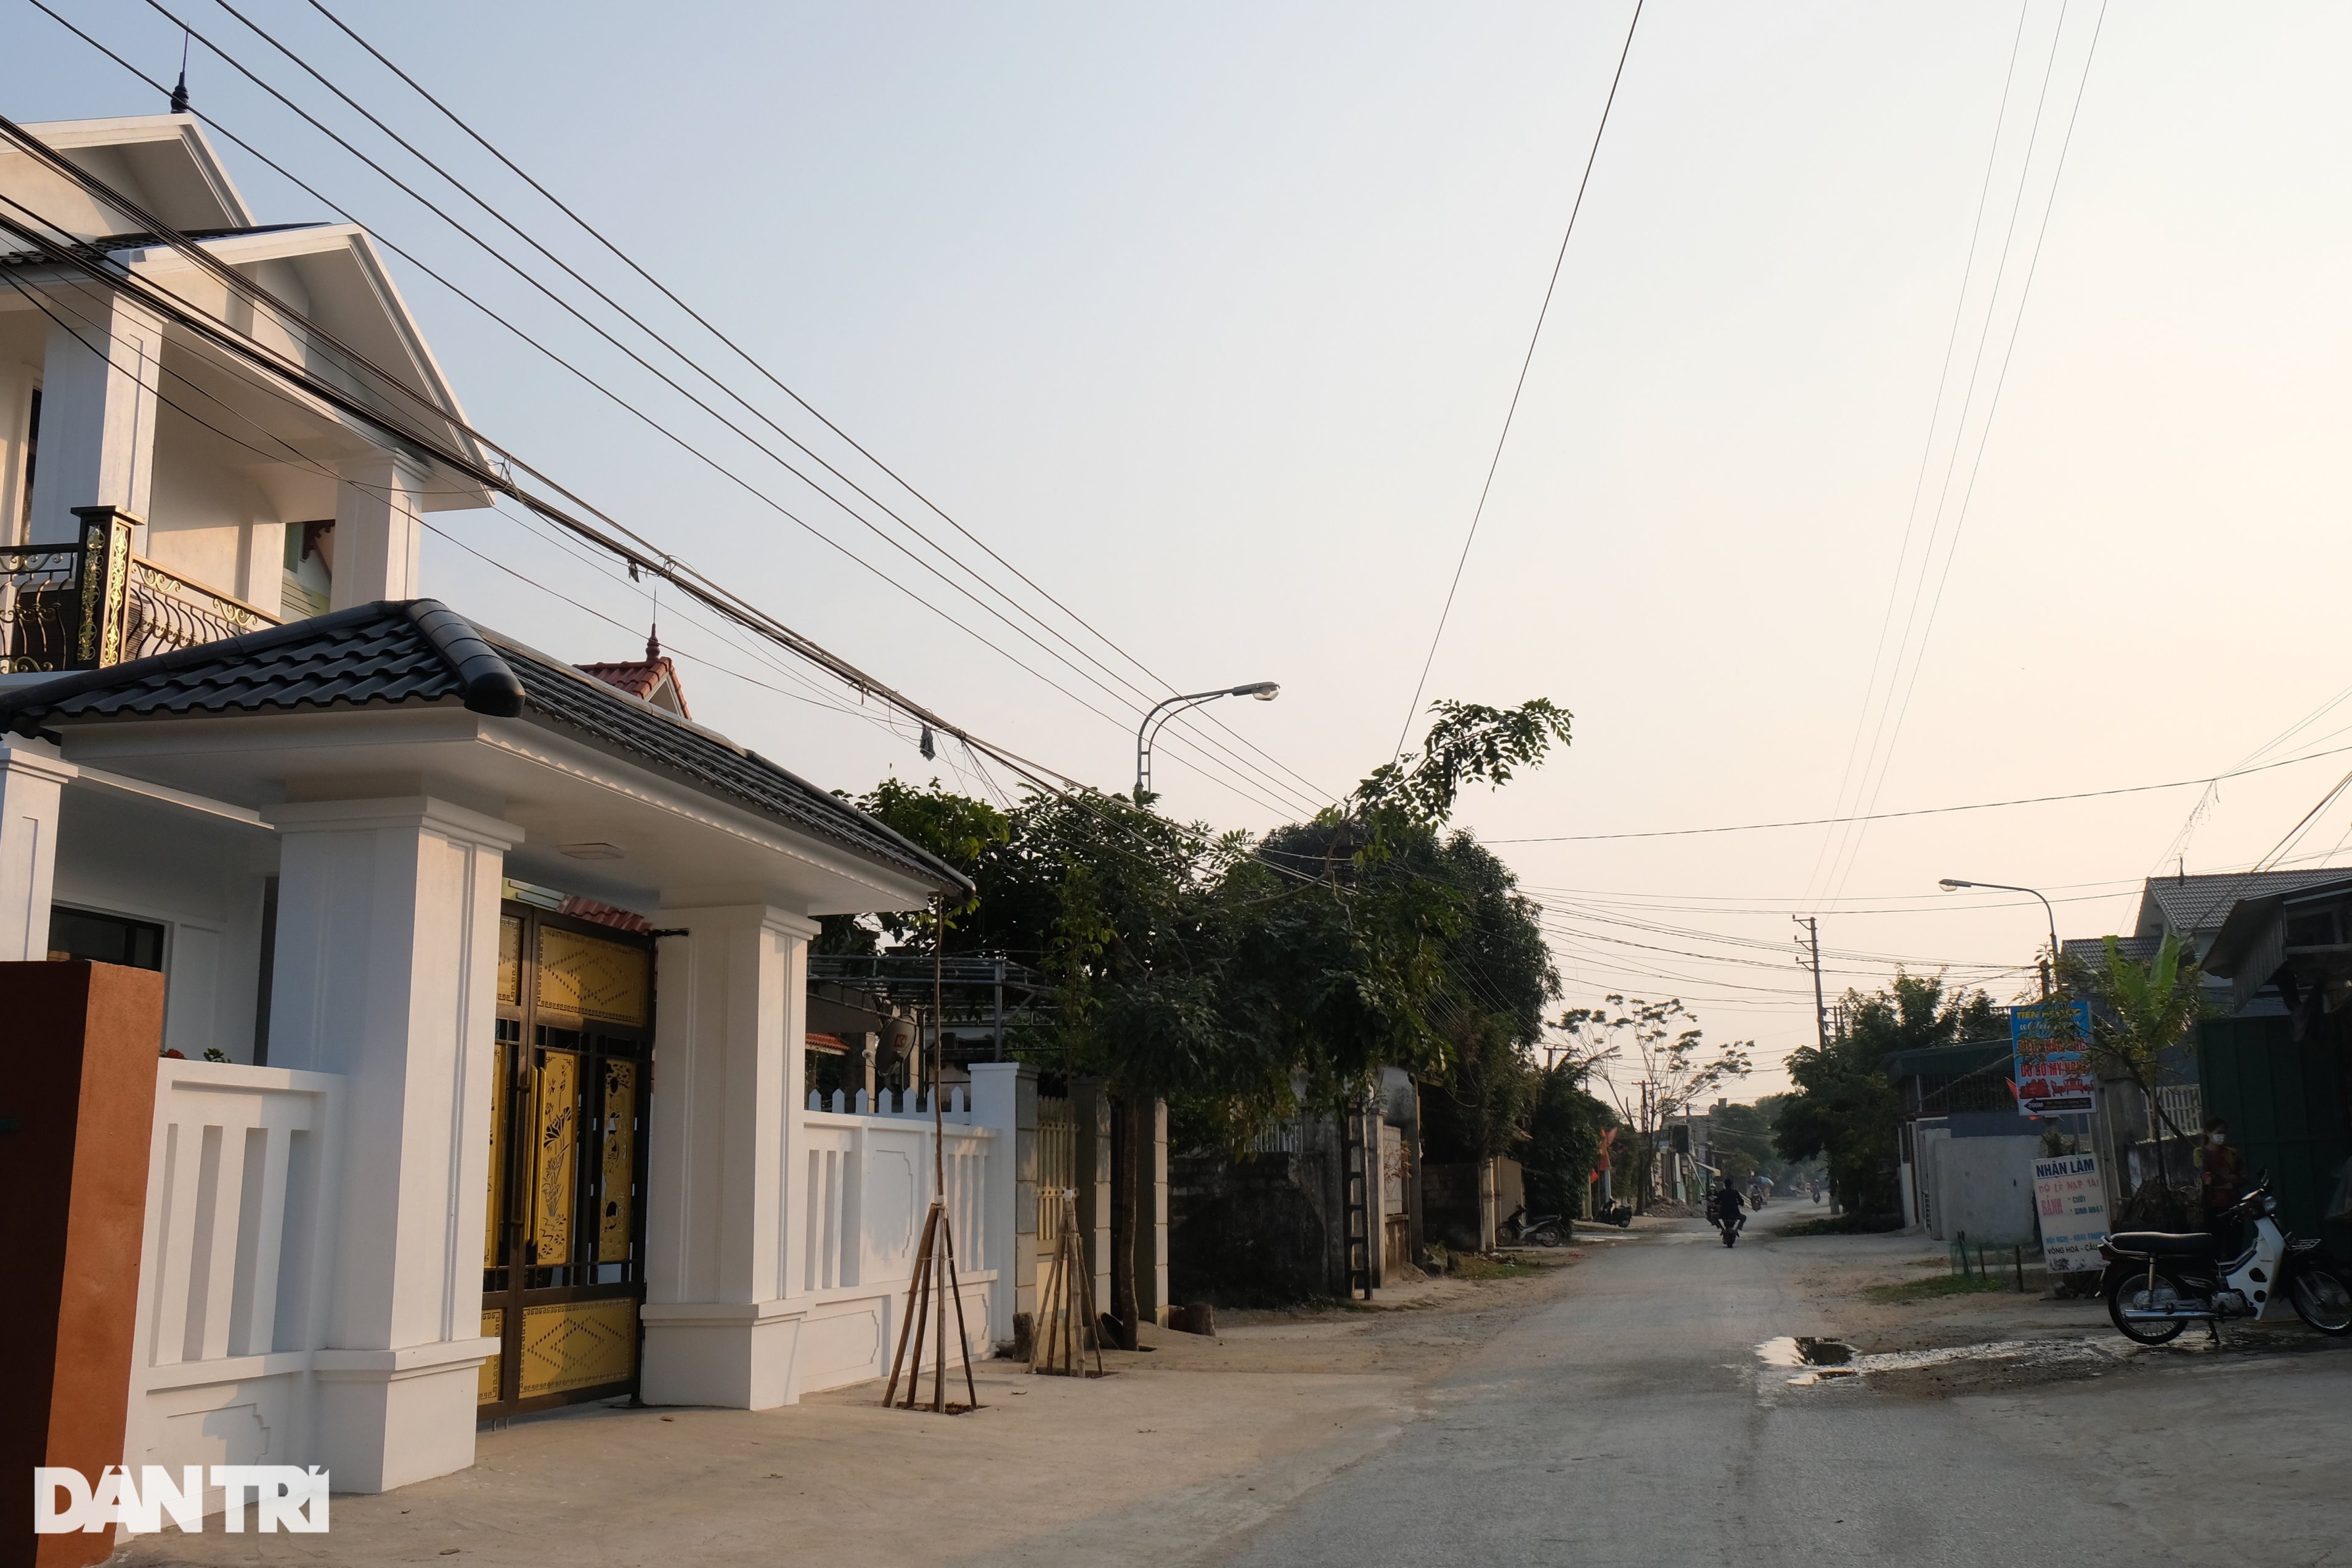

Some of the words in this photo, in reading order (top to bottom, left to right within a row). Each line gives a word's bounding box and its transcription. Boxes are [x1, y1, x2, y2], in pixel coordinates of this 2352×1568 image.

[2036, 1161, 2067, 1178] NHẬN
[2070, 1158, 2094, 1173] LÀM
[2041, 1195, 2063, 1216] BÁNH
[2074, 1207, 2087, 1216] SINH
[2047, 1246, 2065, 1255] VÒNG
[2065, 1245, 2080, 1253] HOA
